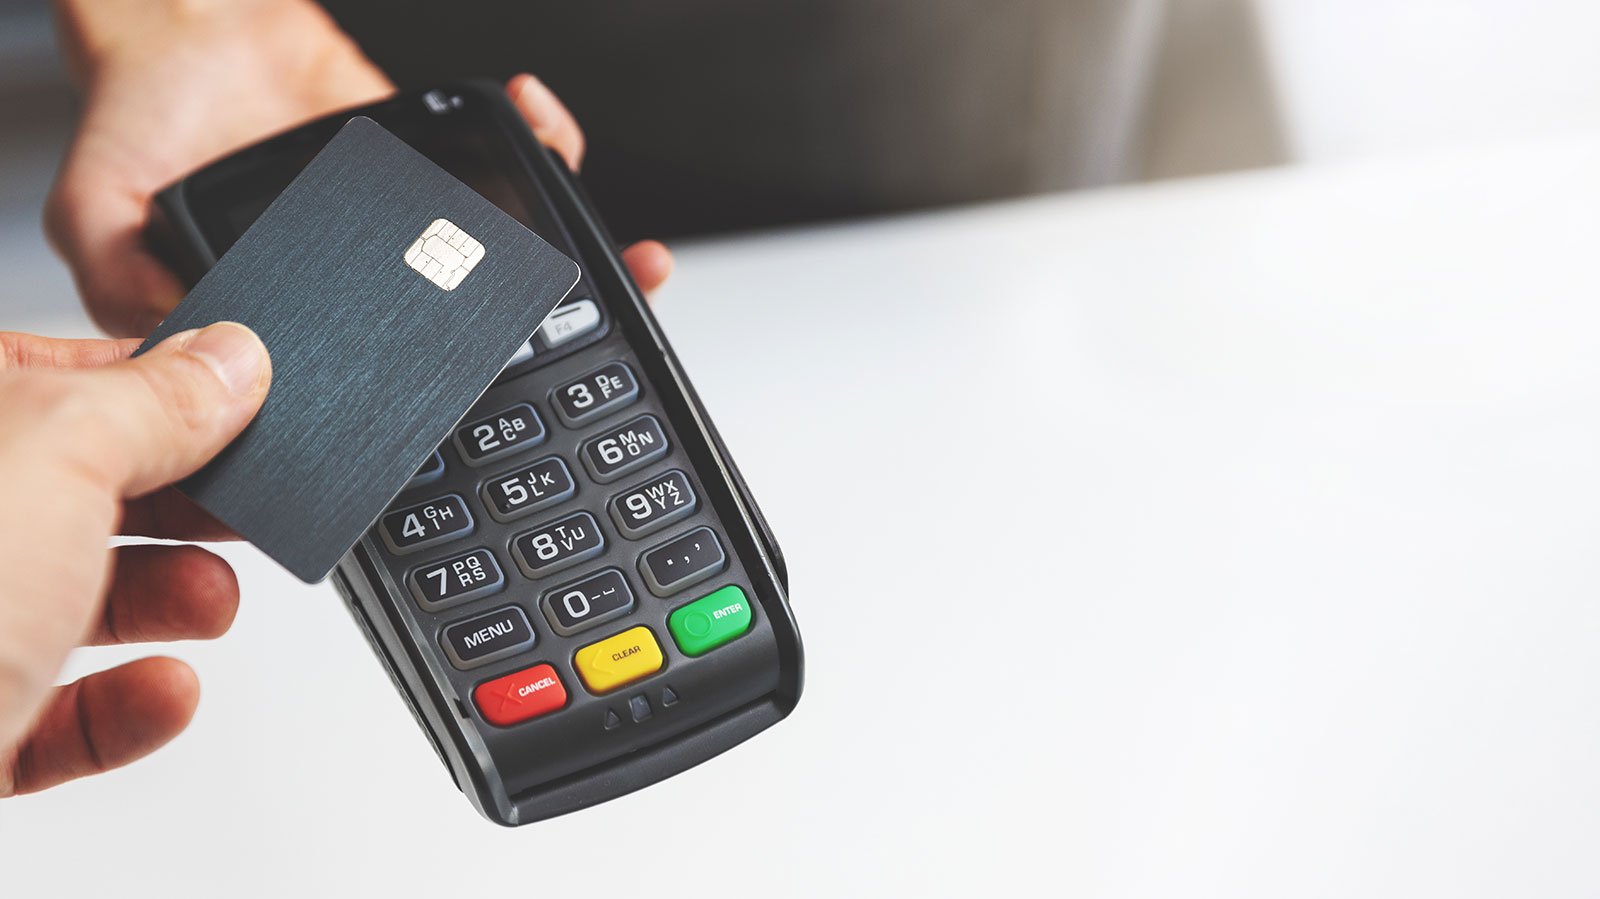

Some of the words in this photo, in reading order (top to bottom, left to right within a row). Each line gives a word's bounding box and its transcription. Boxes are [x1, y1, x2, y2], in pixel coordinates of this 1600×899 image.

[555, 321, 572, 335] F4
[567, 383, 594, 409] 3
[473, 424, 500, 451] 2
[597, 438, 623, 465] 6
[501, 478, 528, 505] 5
[625, 493, 652, 519] 9
[402, 513, 425, 538] 4
[532, 533, 559, 560] 8
[426, 567, 447, 596] 7
[563, 591, 591, 618] 0
[713, 603, 743, 620] ENTER
[463, 619, 514, 649] MENU
[612, 645, 642, 662] CLEAR
[518, 677, 556, 697] CANCEL
